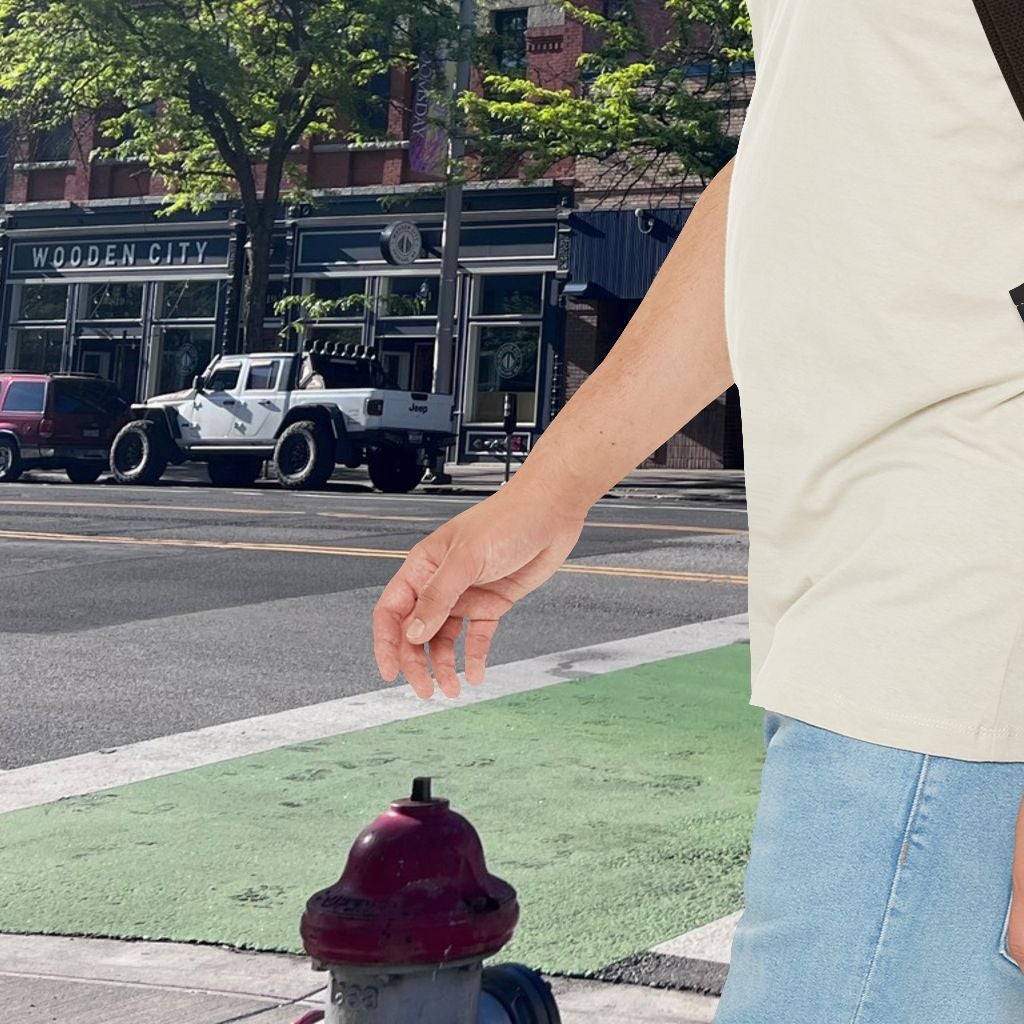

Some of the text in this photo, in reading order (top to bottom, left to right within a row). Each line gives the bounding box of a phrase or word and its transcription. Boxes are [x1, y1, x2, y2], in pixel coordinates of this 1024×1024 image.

[32, 241, 208, 268] WOODEN CITY
[408, 403, 428, 414] Jeep
